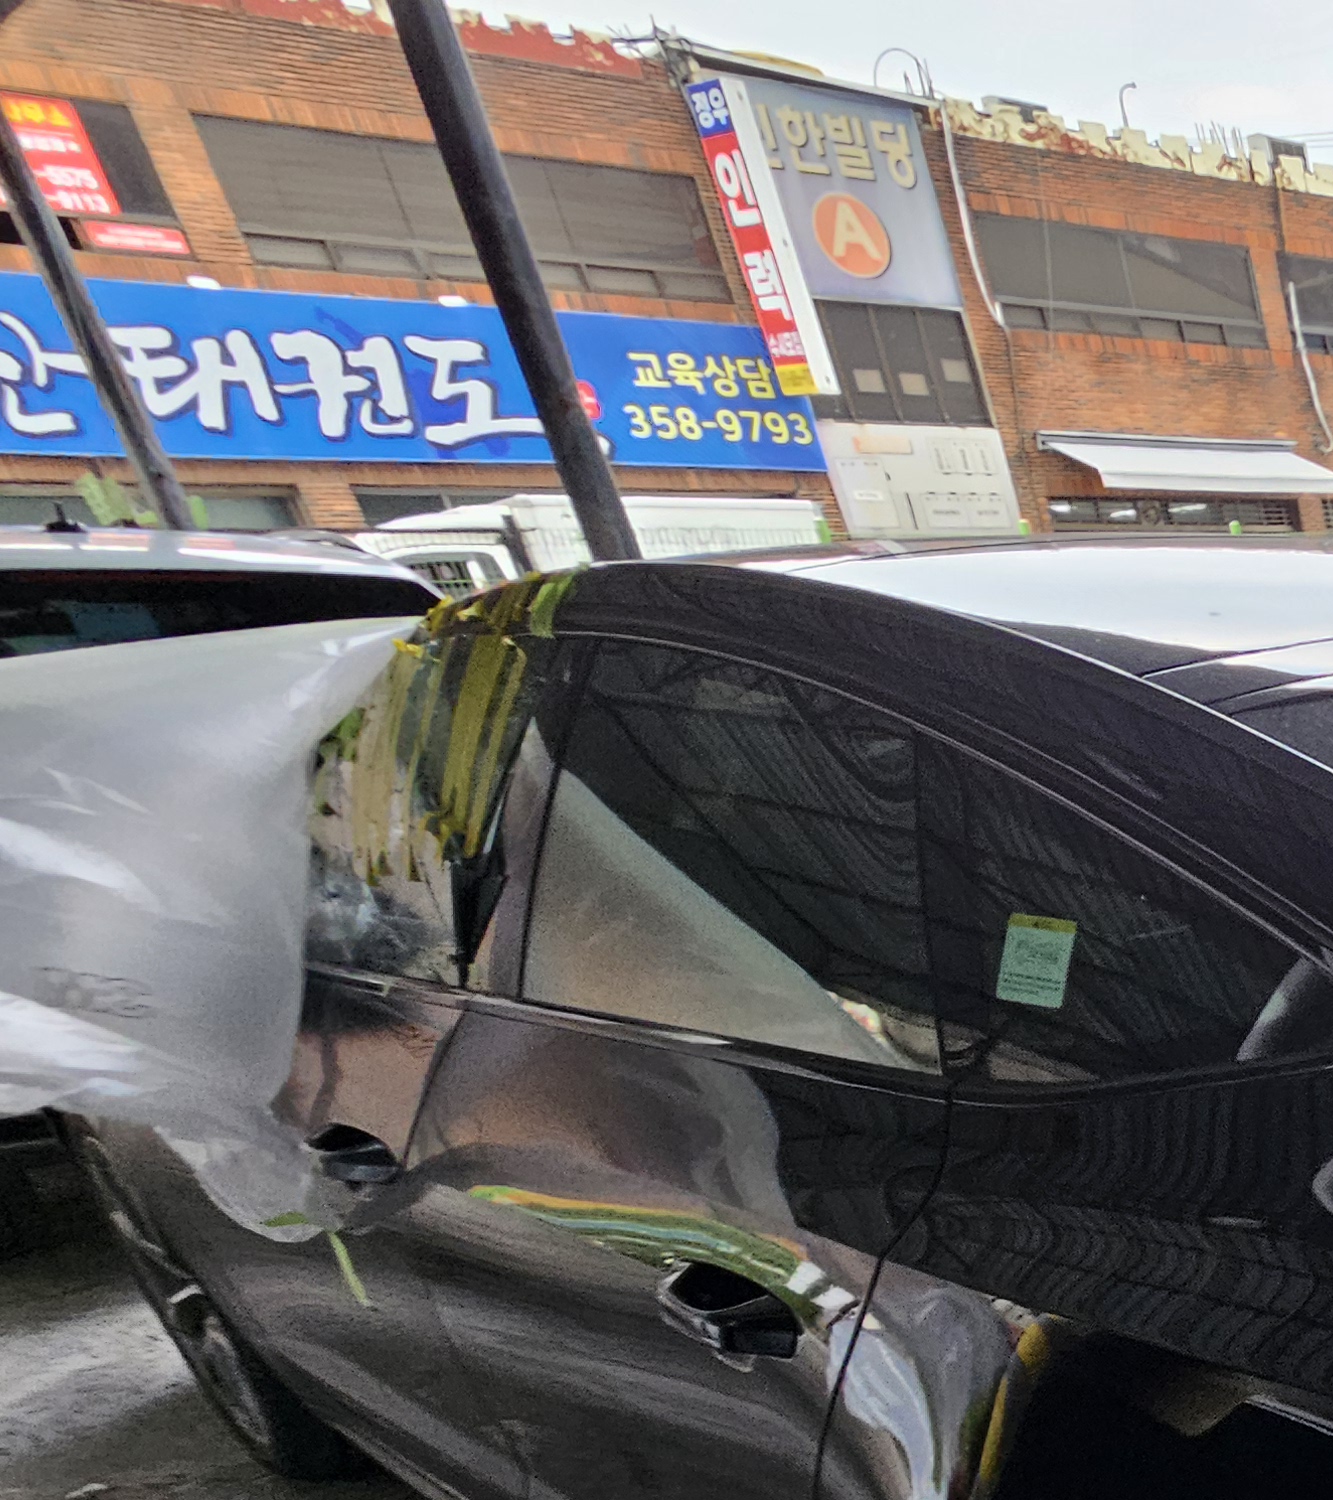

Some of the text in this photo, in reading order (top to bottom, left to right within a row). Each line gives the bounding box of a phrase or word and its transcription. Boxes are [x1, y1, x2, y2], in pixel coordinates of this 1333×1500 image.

[832, 201, 882, 261] A
[627, 352, 777, 399] 교육상담
[622, 403, 814, 445] 358-9793
